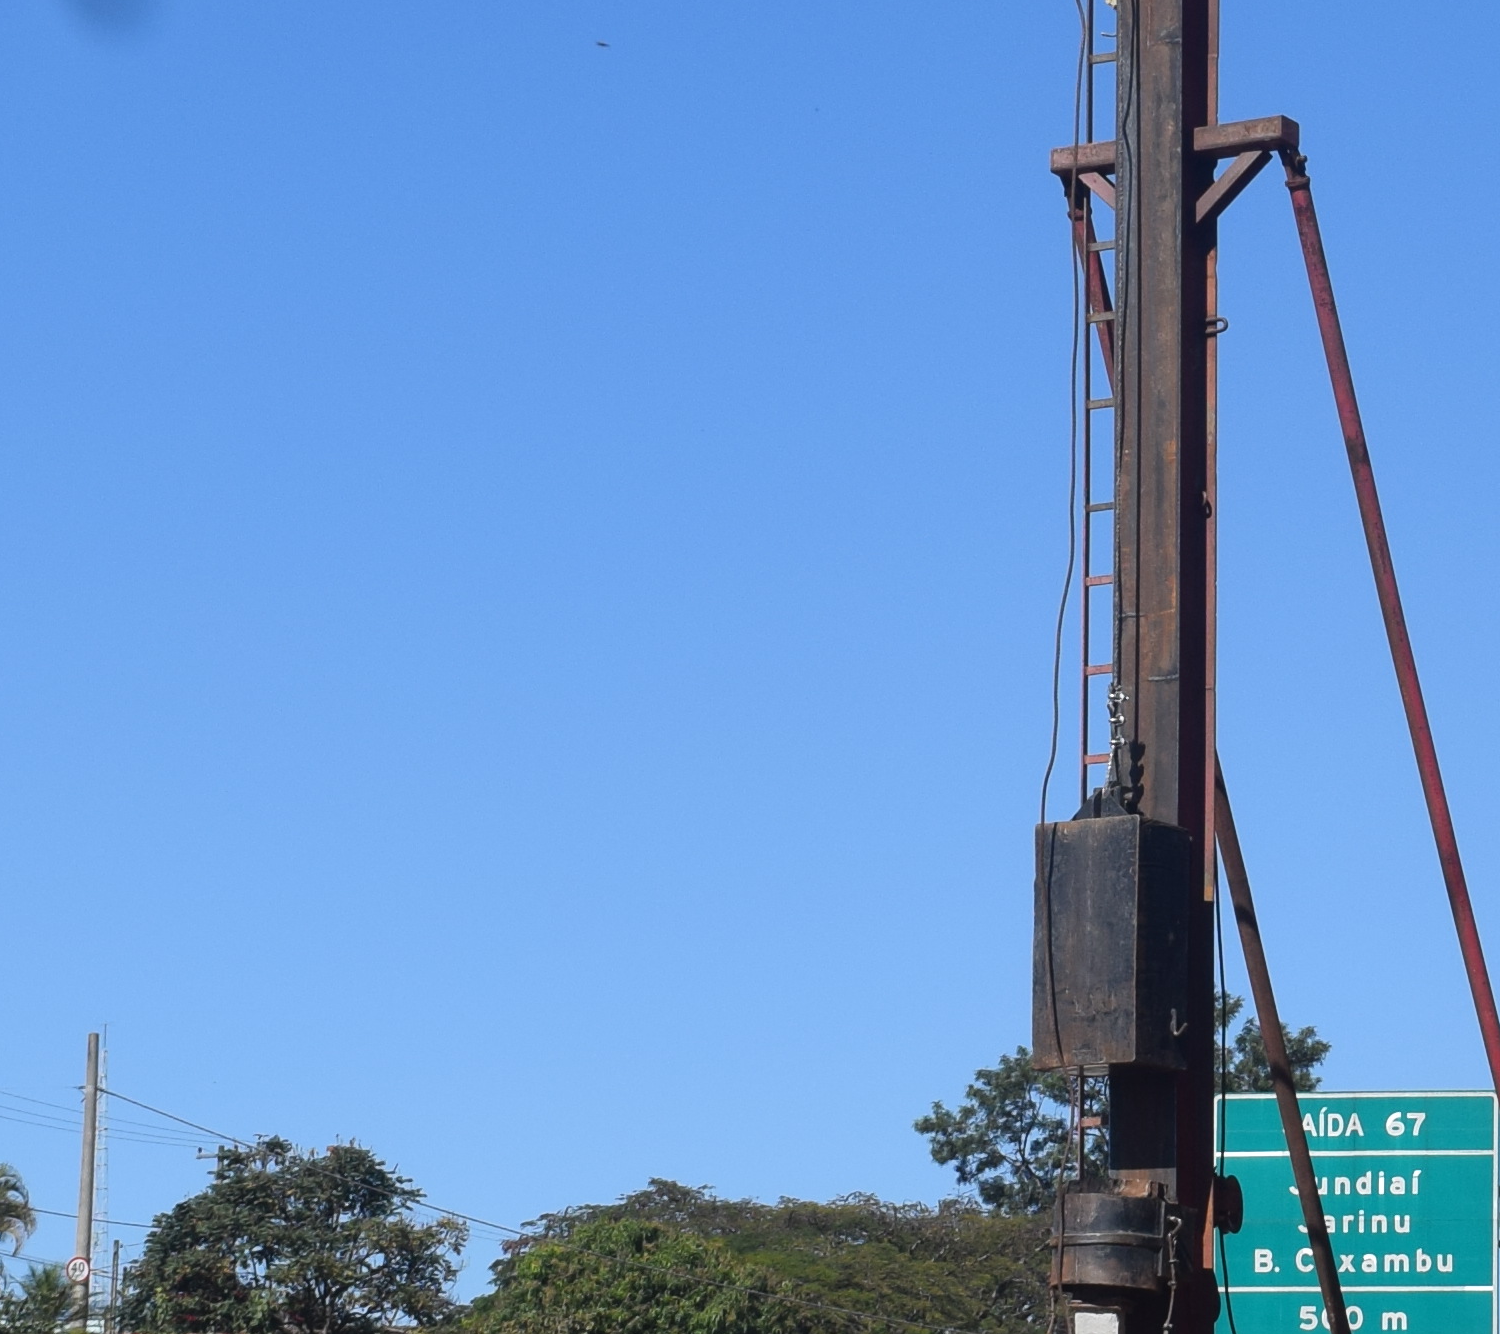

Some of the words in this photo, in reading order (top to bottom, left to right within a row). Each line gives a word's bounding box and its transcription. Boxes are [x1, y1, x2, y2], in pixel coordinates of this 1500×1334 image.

[1282, 1107, 1364, 1137] AÍDA
[1385, 1112, 1425, 1136] 67
[1254, 1248, 1280, 1273] B.
[1295, 1248, 1453, 1273] Cxambu
[1381, 1310, 1407, 1331] m
